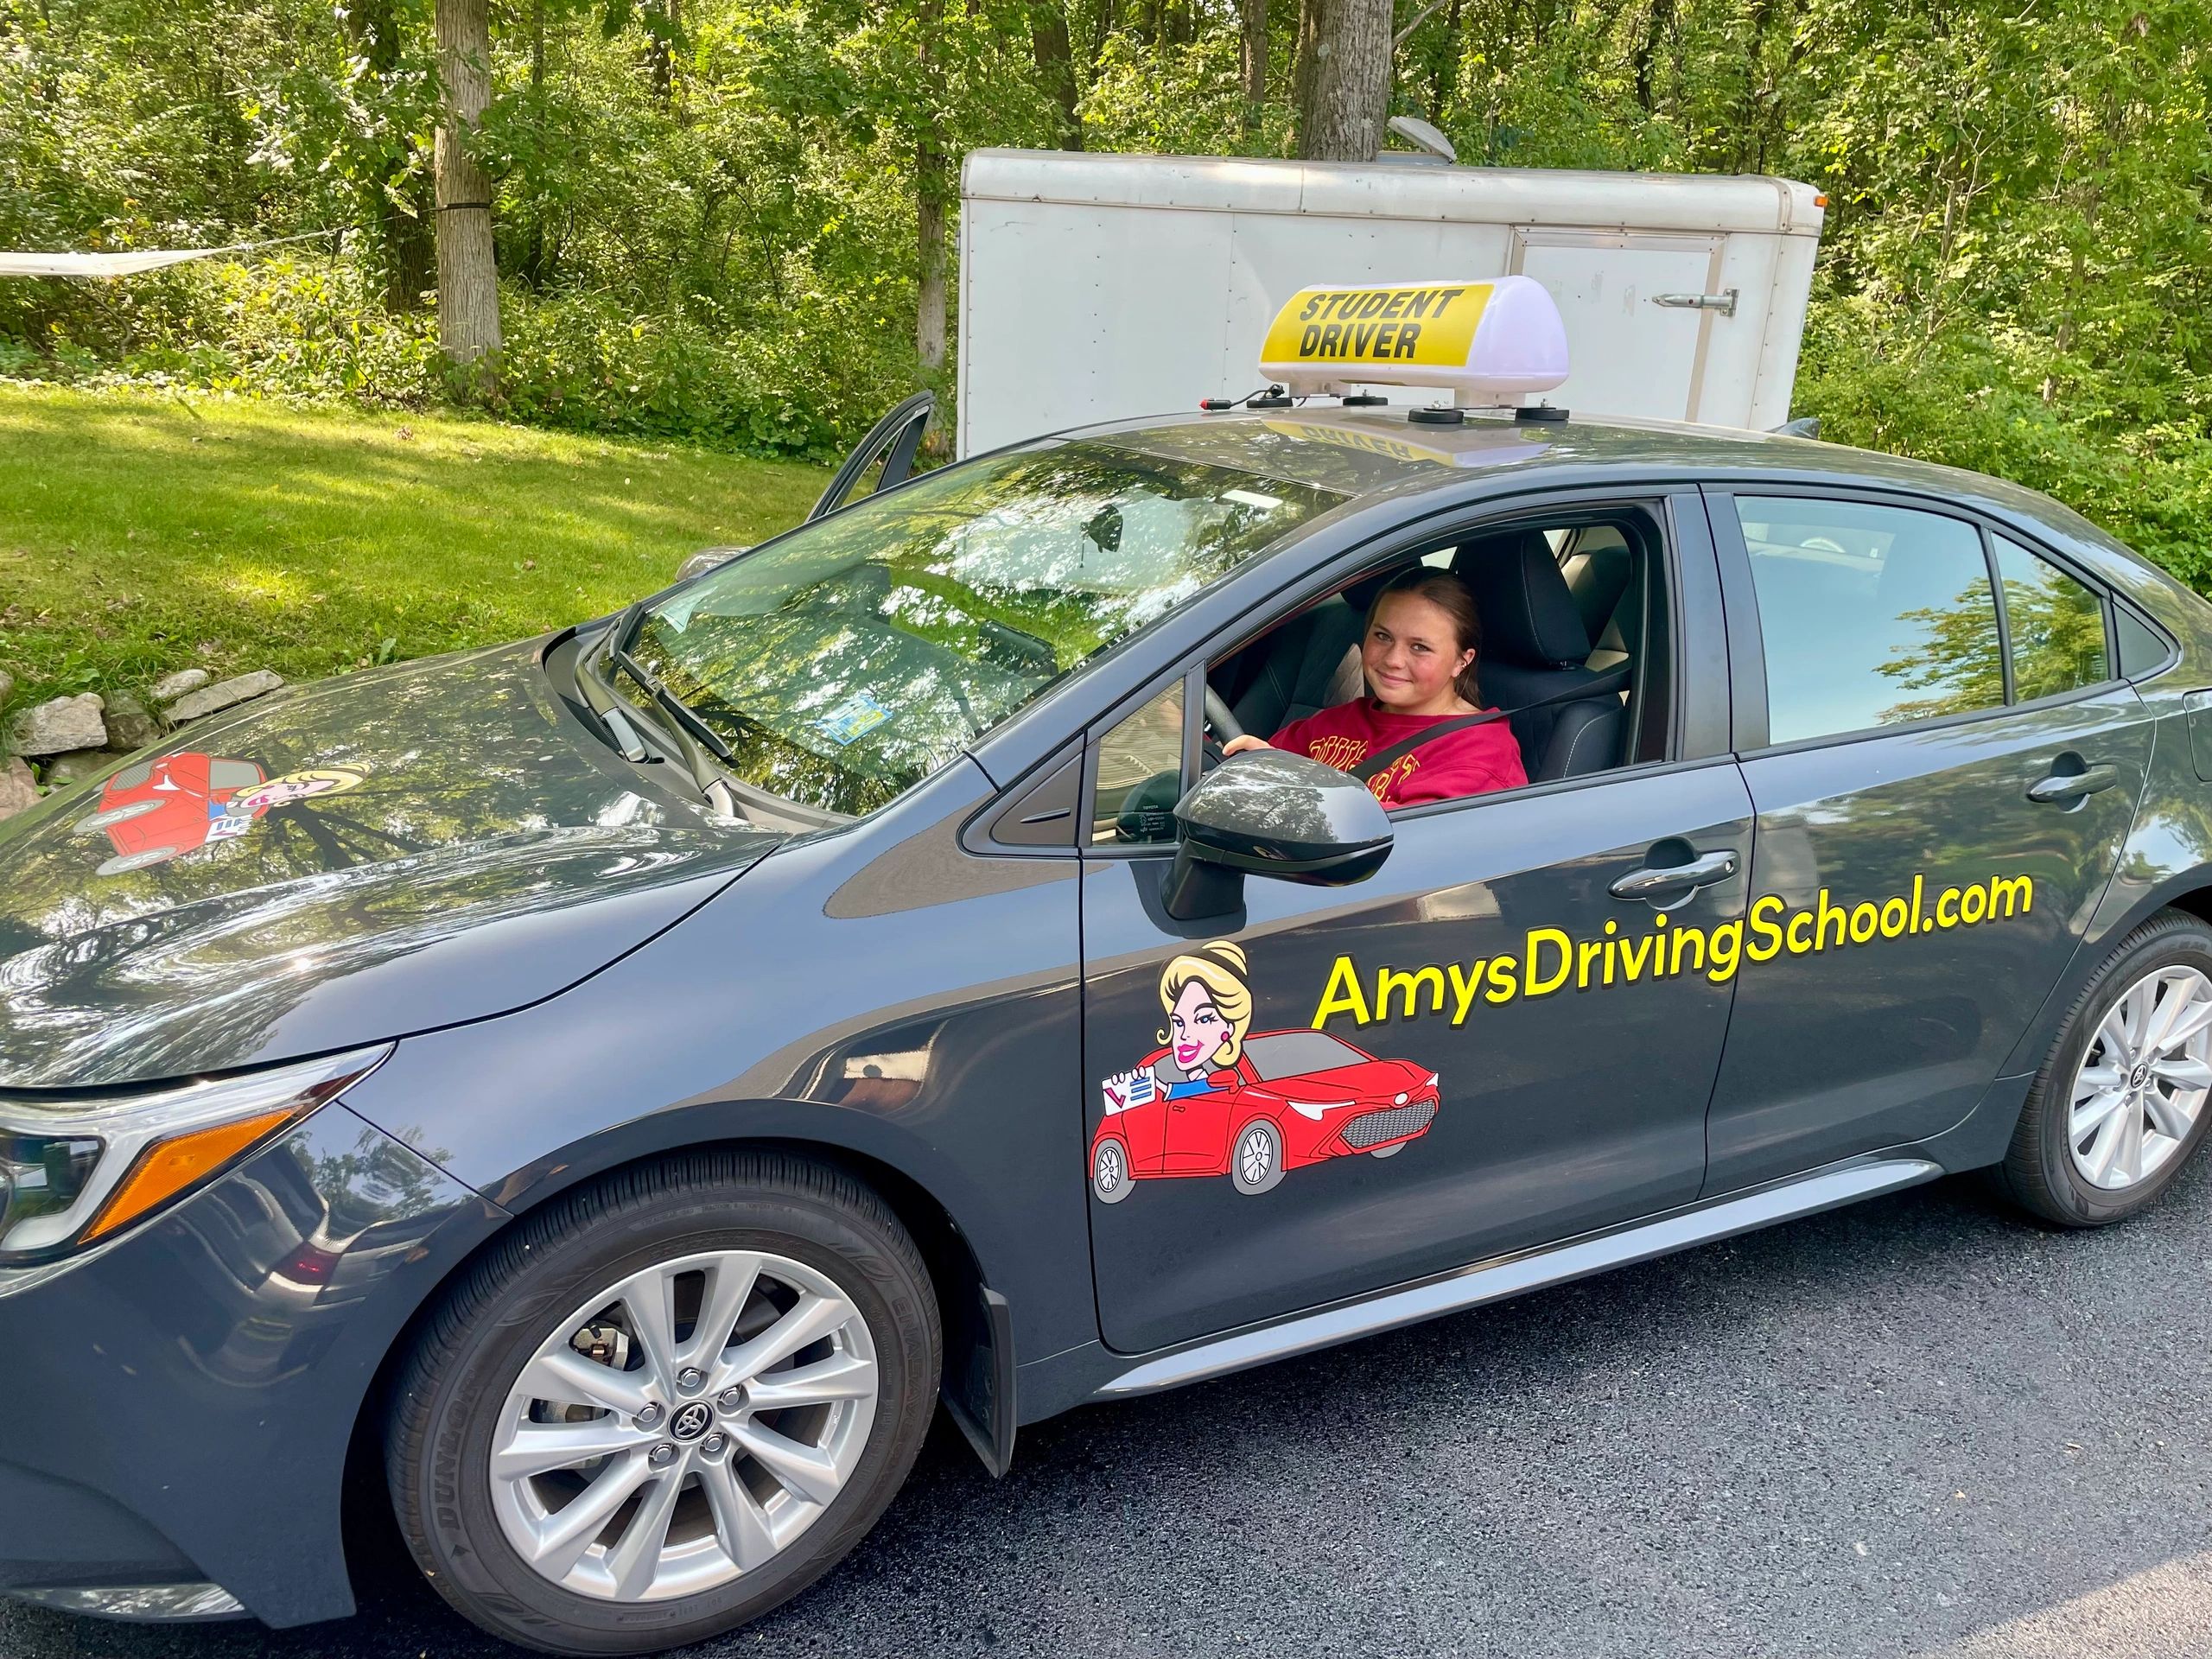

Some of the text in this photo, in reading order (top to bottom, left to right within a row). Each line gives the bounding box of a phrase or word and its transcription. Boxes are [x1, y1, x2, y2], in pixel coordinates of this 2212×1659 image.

[1300, 289, 1464, 321] STUDENT
[1299, 323, 1422, 359] DRIVER
[1312, 875, 2032, 1029] AmysDrivingSchool.com
